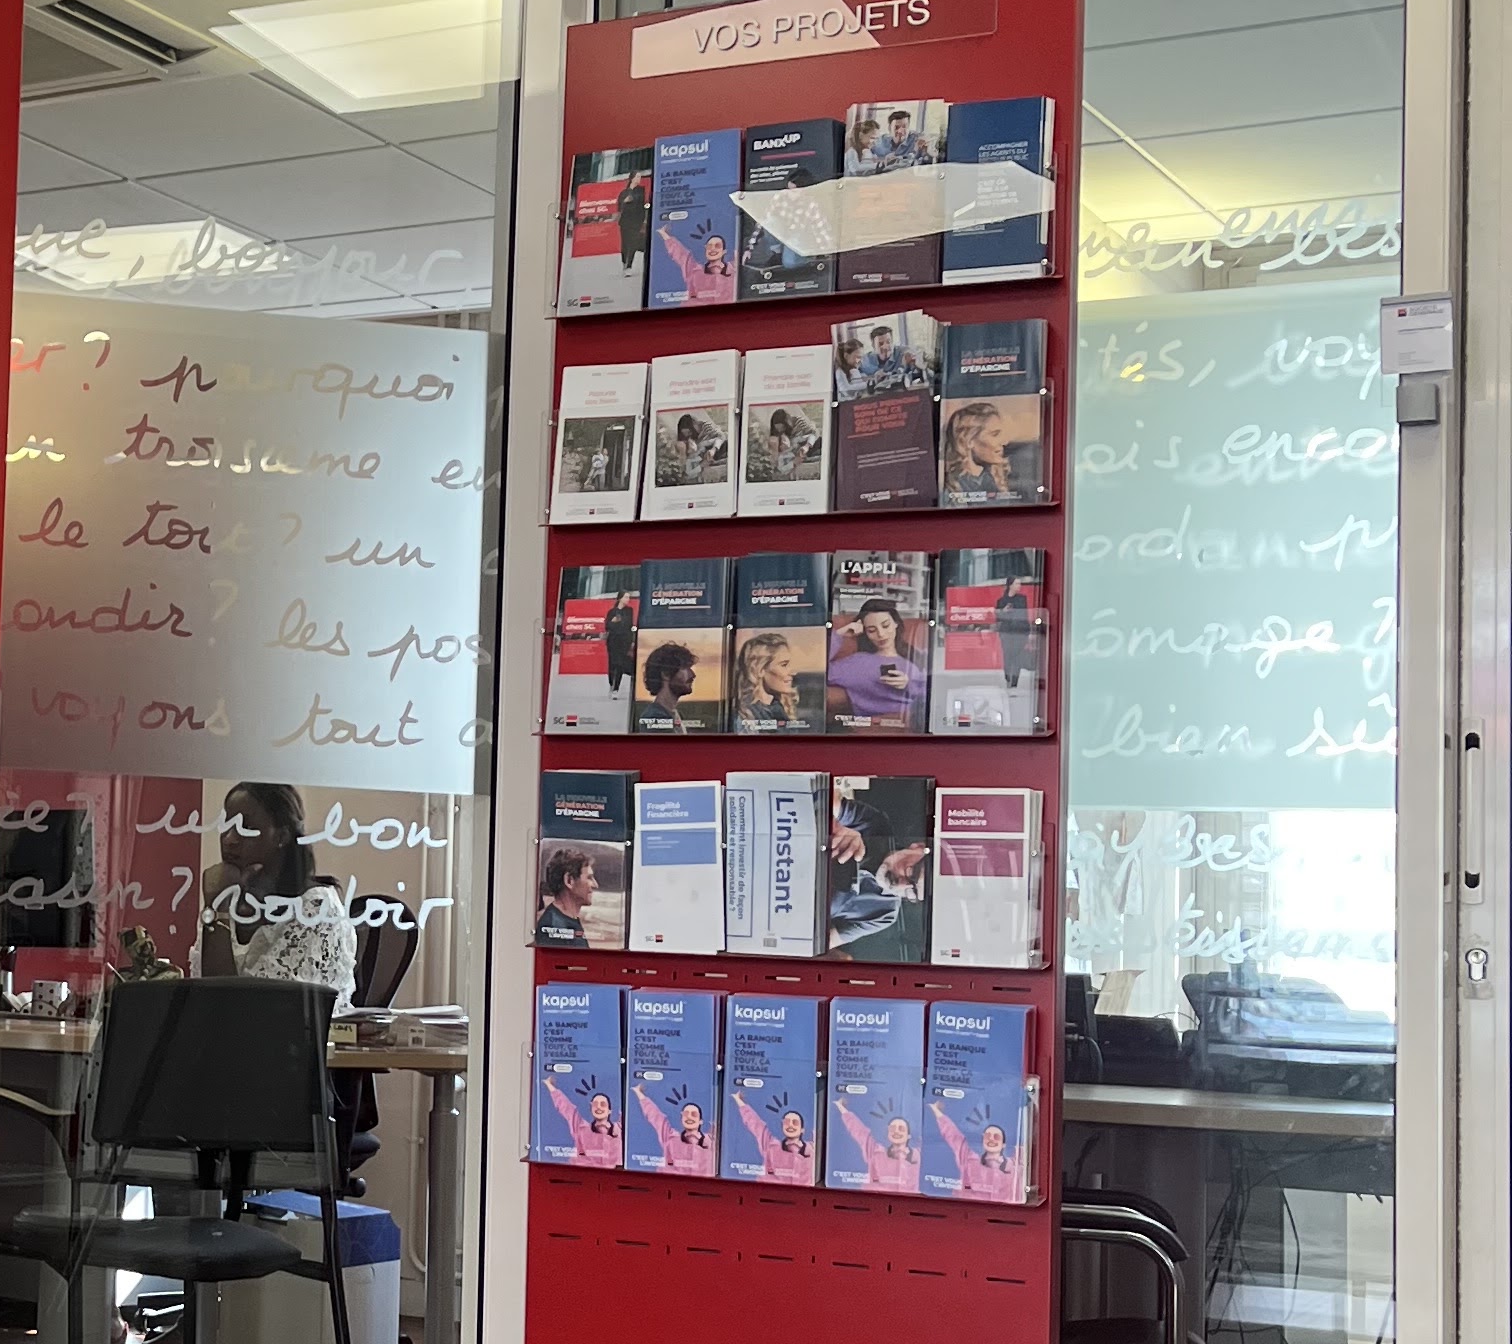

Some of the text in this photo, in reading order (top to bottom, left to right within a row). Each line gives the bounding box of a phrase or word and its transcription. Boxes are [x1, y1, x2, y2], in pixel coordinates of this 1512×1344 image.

[694, 19, 762, 54] VOS
[660, 139, 709, 157] kapsul
[960, 362, 1011, 374] D'ÉPARGNE
[841, 560, 897, 575] L'APPLI
[651, 590, 704, 598] GÉNÉRATION
[752, 587, 805, 596] GÉNÉRATION
[651, 596, 698, 606] D'ÉPARGNE
[751, 594, 799, 605] D'ÉPARGNE
[555, 801, 605, 811] GÉNÉRATION
[646, 801, 681, 811] Fragilité
[555, 808, 600, 818] D'ÉPARGNE
[646, 810, 689, 819] financière
[729, 796, 737, 835] solidaire
[947, 808, 985, 818] Mobilité
[296, 800, 450, 851] bon
[947, 817, 987, 826] bancaire
[729, 838, 736, 846] et
[737, 795, 747, 920] Comment investir de façon
[774, 797, 799, 914] L'instant
[728, 849, 737, 905] responsable
[212, 872, 458, 934] vouloir
[542, 993, 590, 1010] kapsul
[634, 998, 684, 1015] kapsul
[734, 1004, 786, 1022] kapsul
[836, 1009, 890, 1027] kapsul
[555, 1021, 588, 1030] BANQUE
[935, 1011, 991, 1032] kapsul
[647, 1029, 681, 1037] BANQUE
[634, 1035, 656, 1043] C'EST
[747, 1034, 783, 1043] BANQUE
[634, 1043, 665, 1051] COMME
[948, 1043, 986, 1054] BANQUE
[734, 1049, 766, 1057] COMME
[934, 1050, 958, 1058] C'EST
[934, 1058, 967, 1068] COMME
